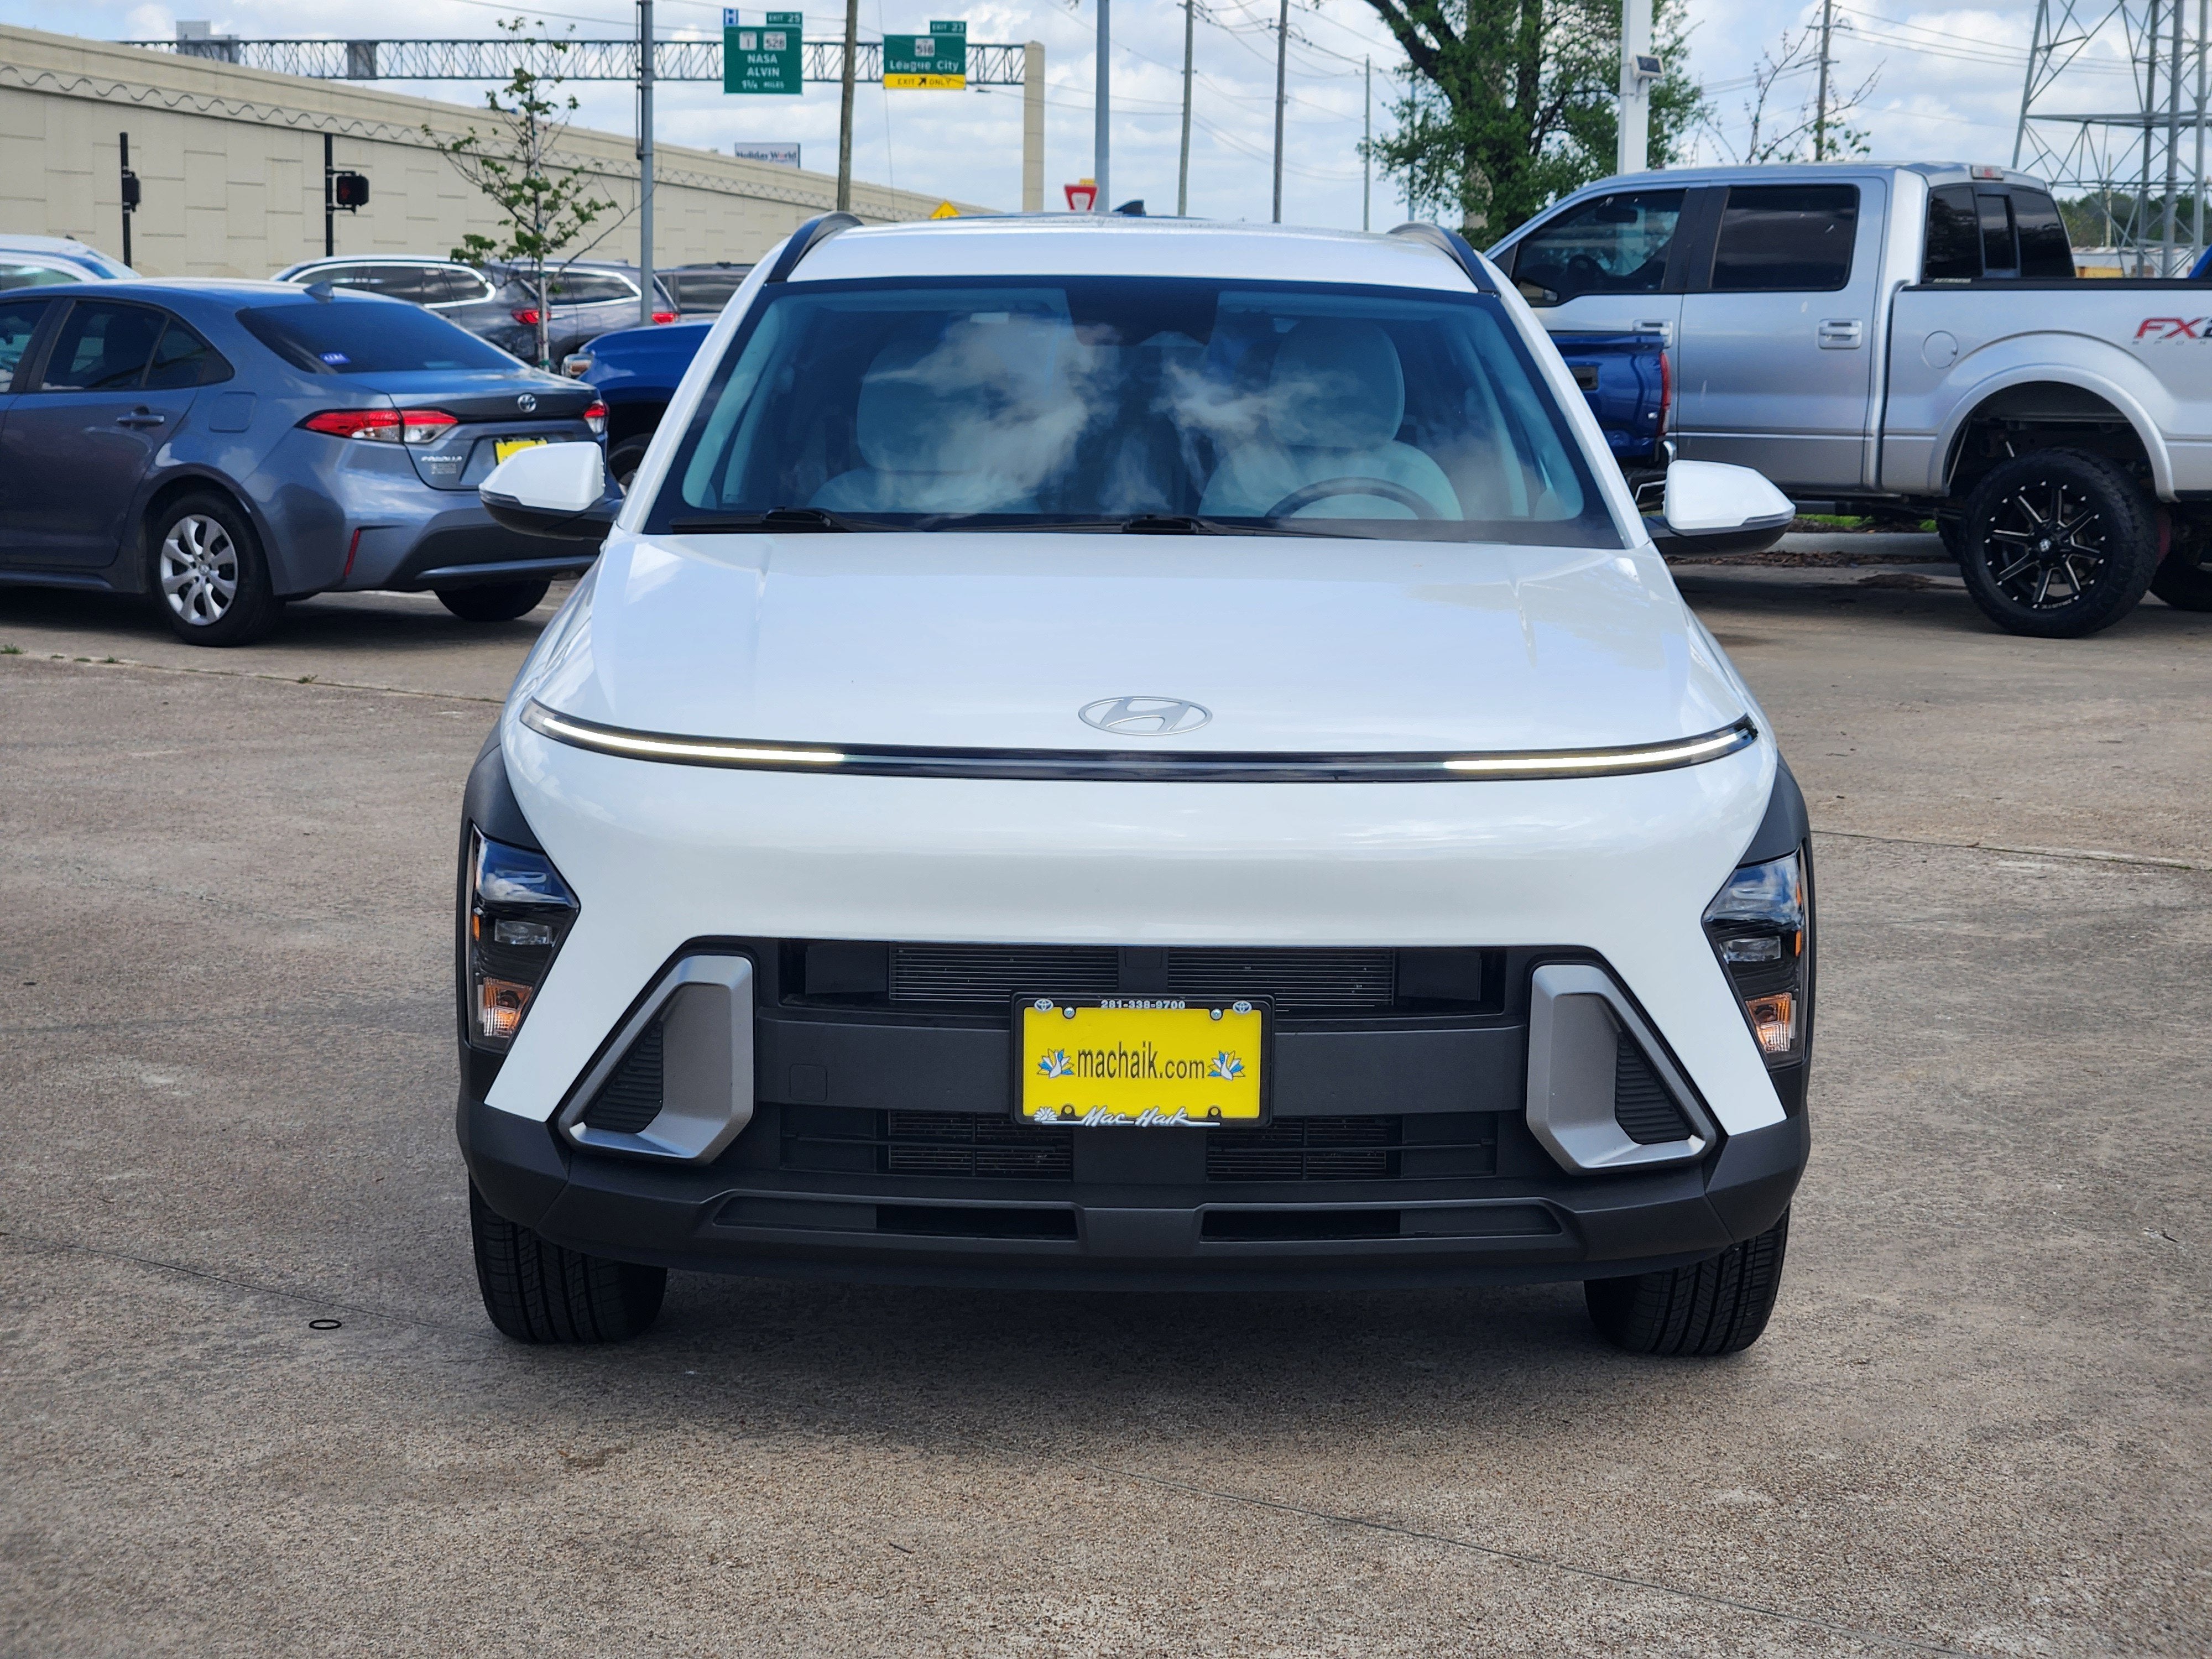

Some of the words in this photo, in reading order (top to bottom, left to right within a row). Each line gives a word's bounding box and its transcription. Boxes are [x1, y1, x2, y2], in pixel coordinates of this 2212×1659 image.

[747, 54, 778, 64] NASA
[889, 59, 931, 72] League
[937, 59, 959, 73] City
[747, 67, 780, 77] ALVIN
[770, 150, 796, 160] World
[1100, 999, 1186, 1009] 281-338-9700
[1077, 1040, 1205, 1079] machaik.com
[1080, 1105, 1134, 1127] Mac
[1134, 1105, 1189, 1127] Haik
